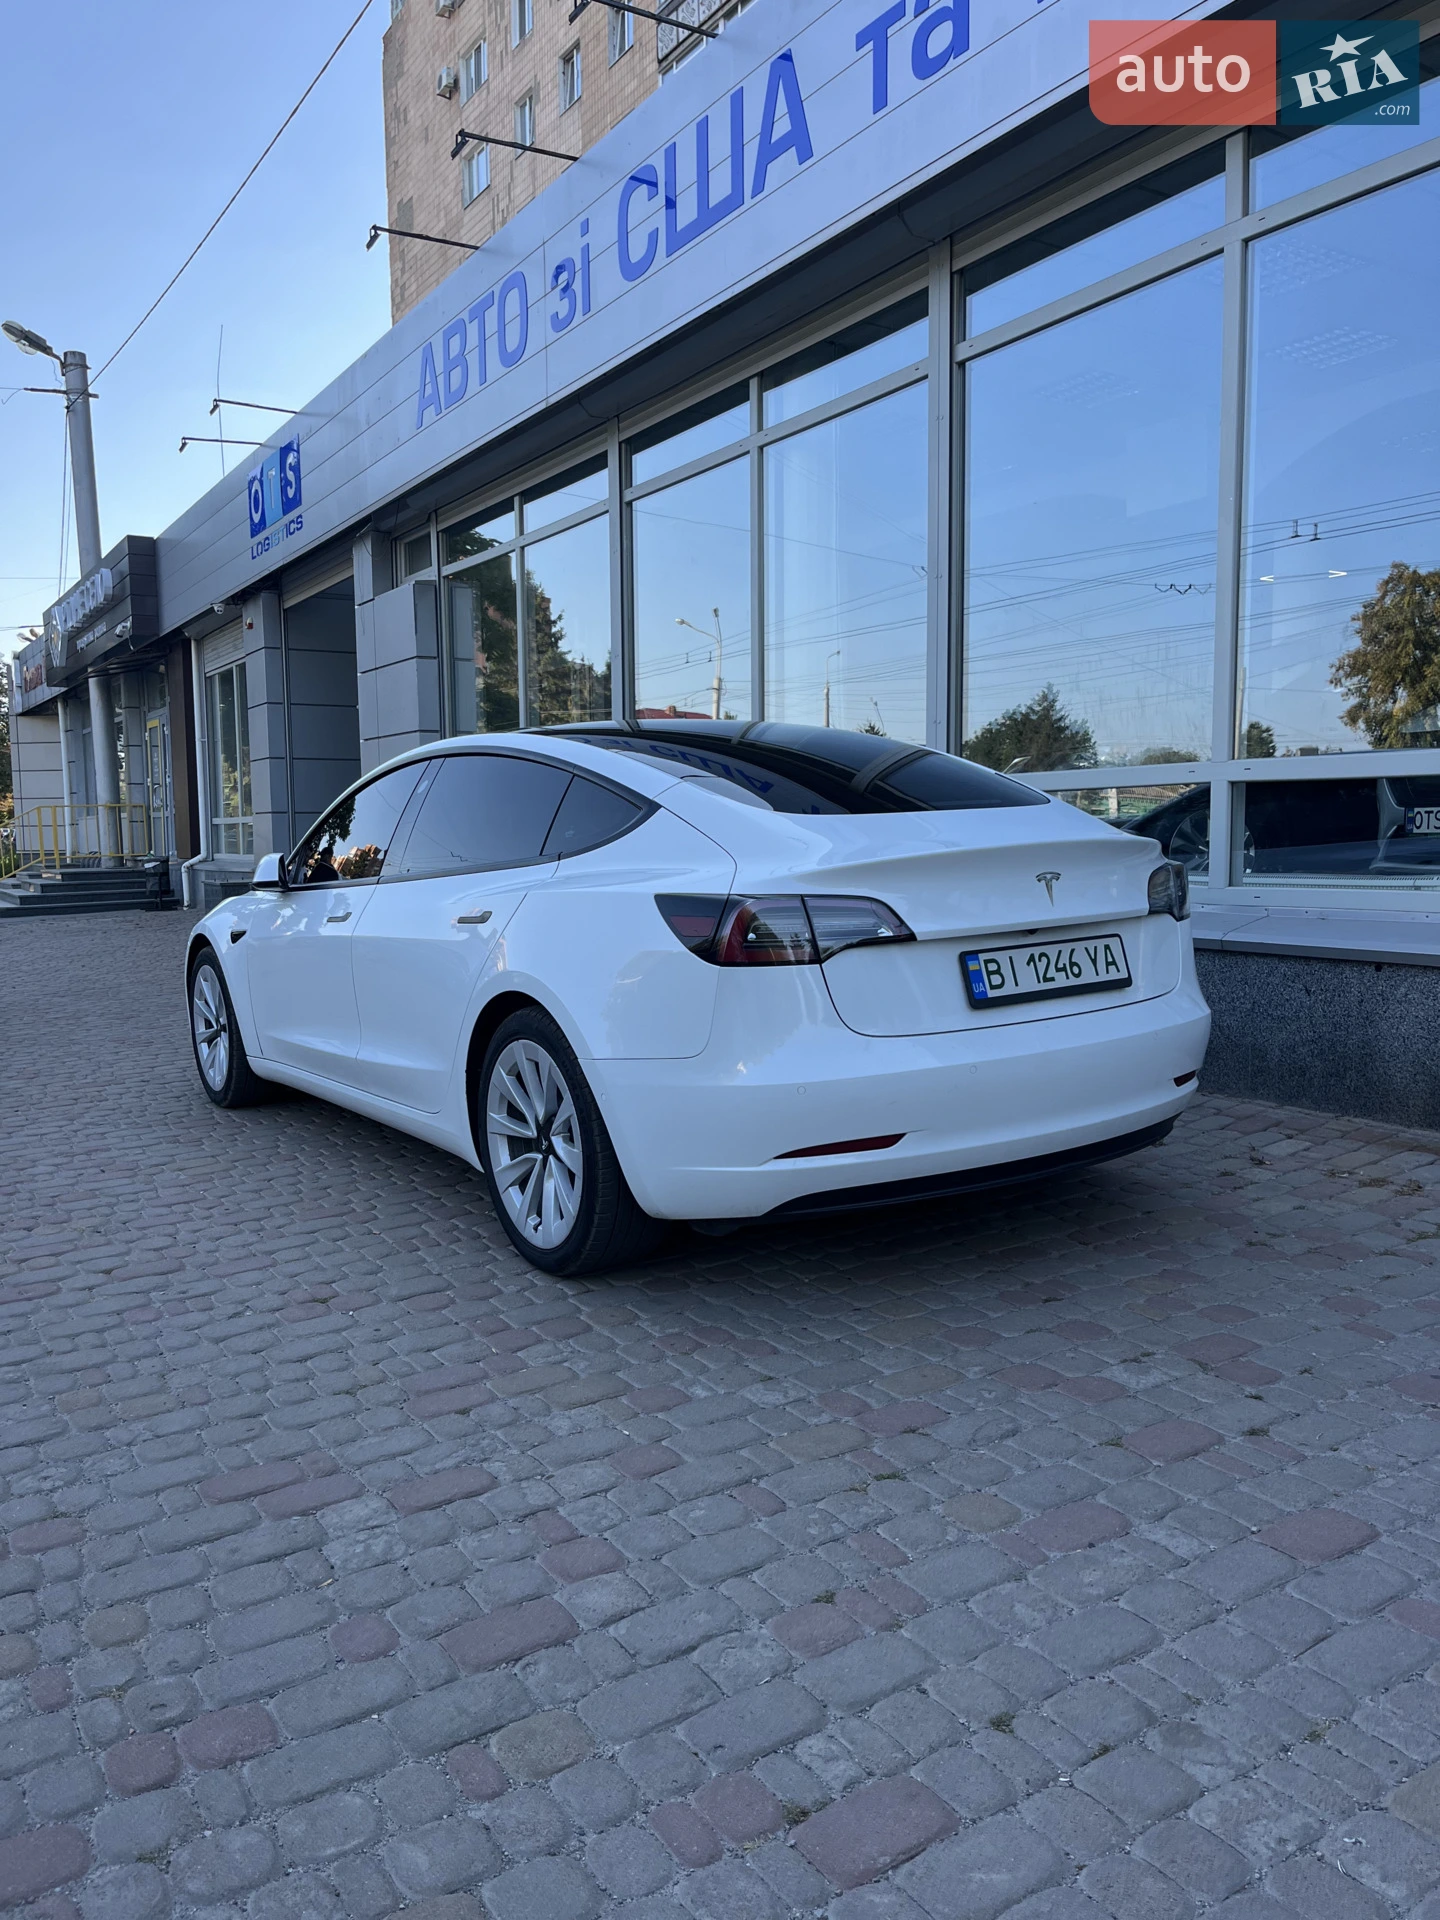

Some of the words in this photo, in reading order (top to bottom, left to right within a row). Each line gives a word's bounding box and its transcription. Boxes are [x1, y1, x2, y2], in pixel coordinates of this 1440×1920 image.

[416, 271, 529, 430] АВТО
[551, 218, 591, 333] зі
[617, 48, 814, 282] США
[855, 0, 970, 115] та
[250, 450, 296, 524] OTS
[251, 514, 303, 560] LOGISTICS
[973, 982, 986, 993] UA
[983, 958, 1019, 990] BI
[1026, 951, 1082, 984] 1246
[1085, 943, 1121, 976] YA
